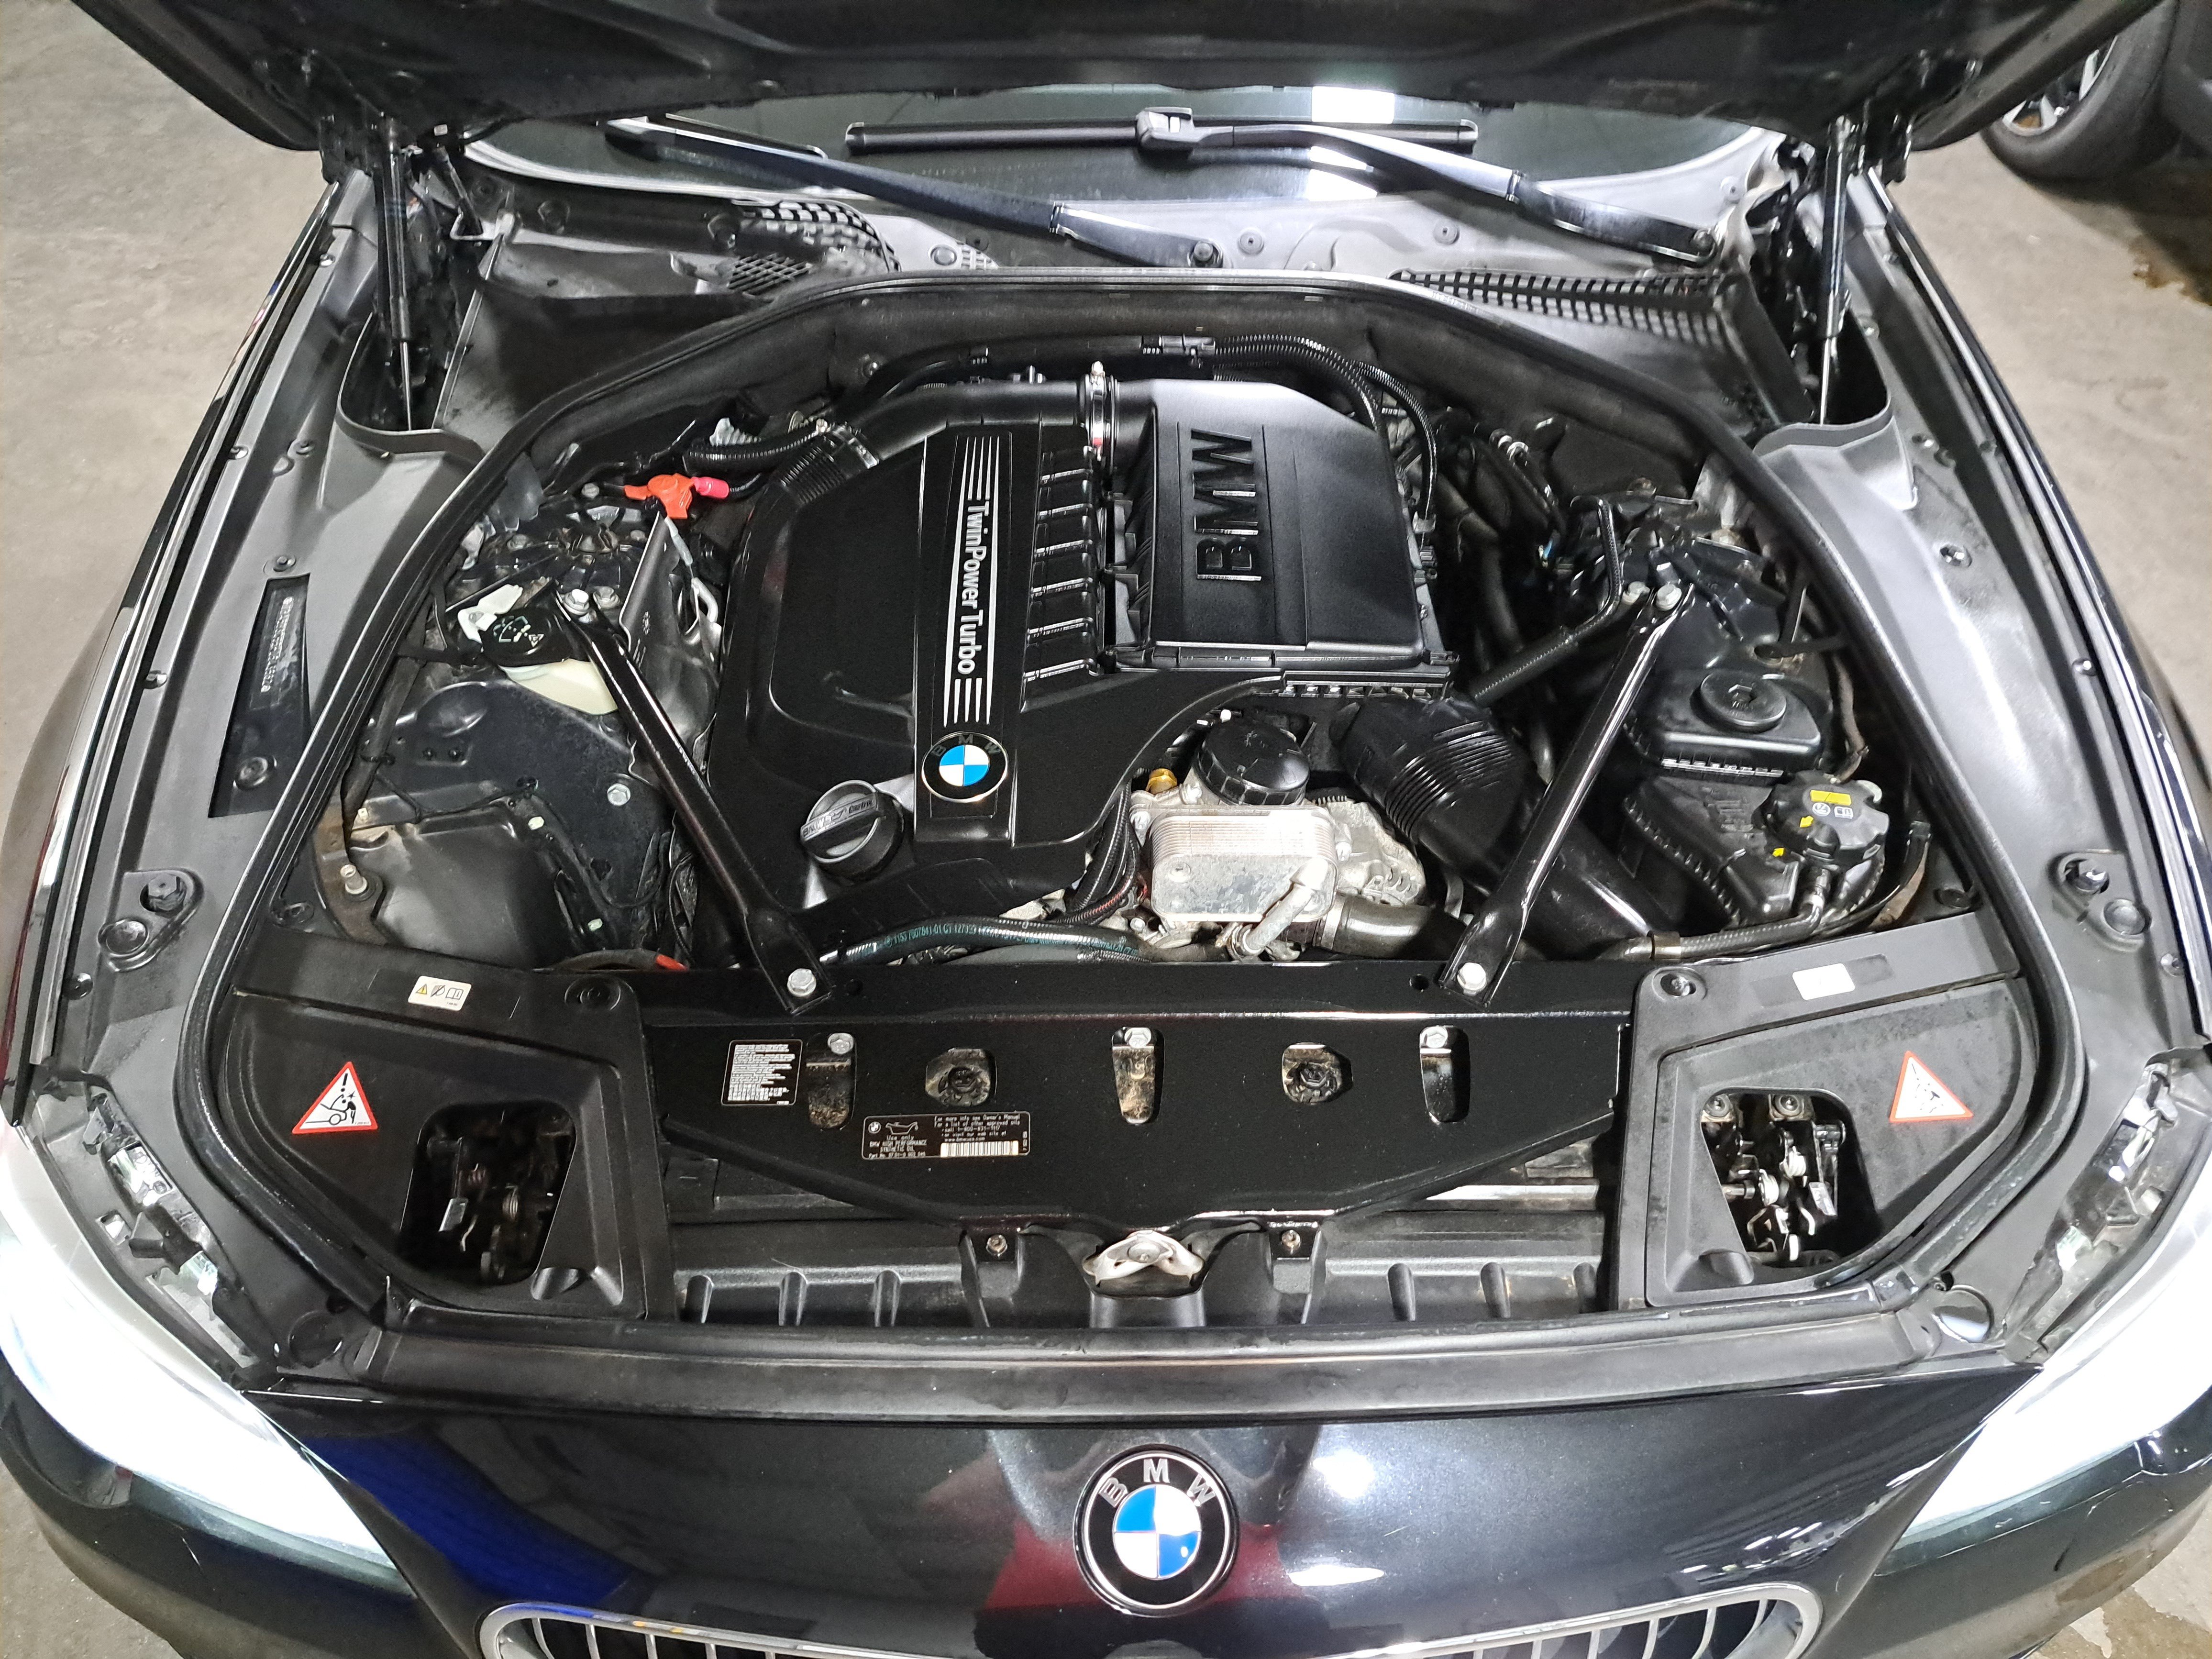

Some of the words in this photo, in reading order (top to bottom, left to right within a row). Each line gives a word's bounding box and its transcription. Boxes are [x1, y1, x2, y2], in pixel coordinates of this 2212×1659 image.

[1191, 428, 1261, 582] BMW
[962, 501, 989, 609] TwinPower
[957, 609, 984, 675] Turbo
[933, 734, 1001, 757] BMW
[1098, 1458, 1216, 1508] BMW
